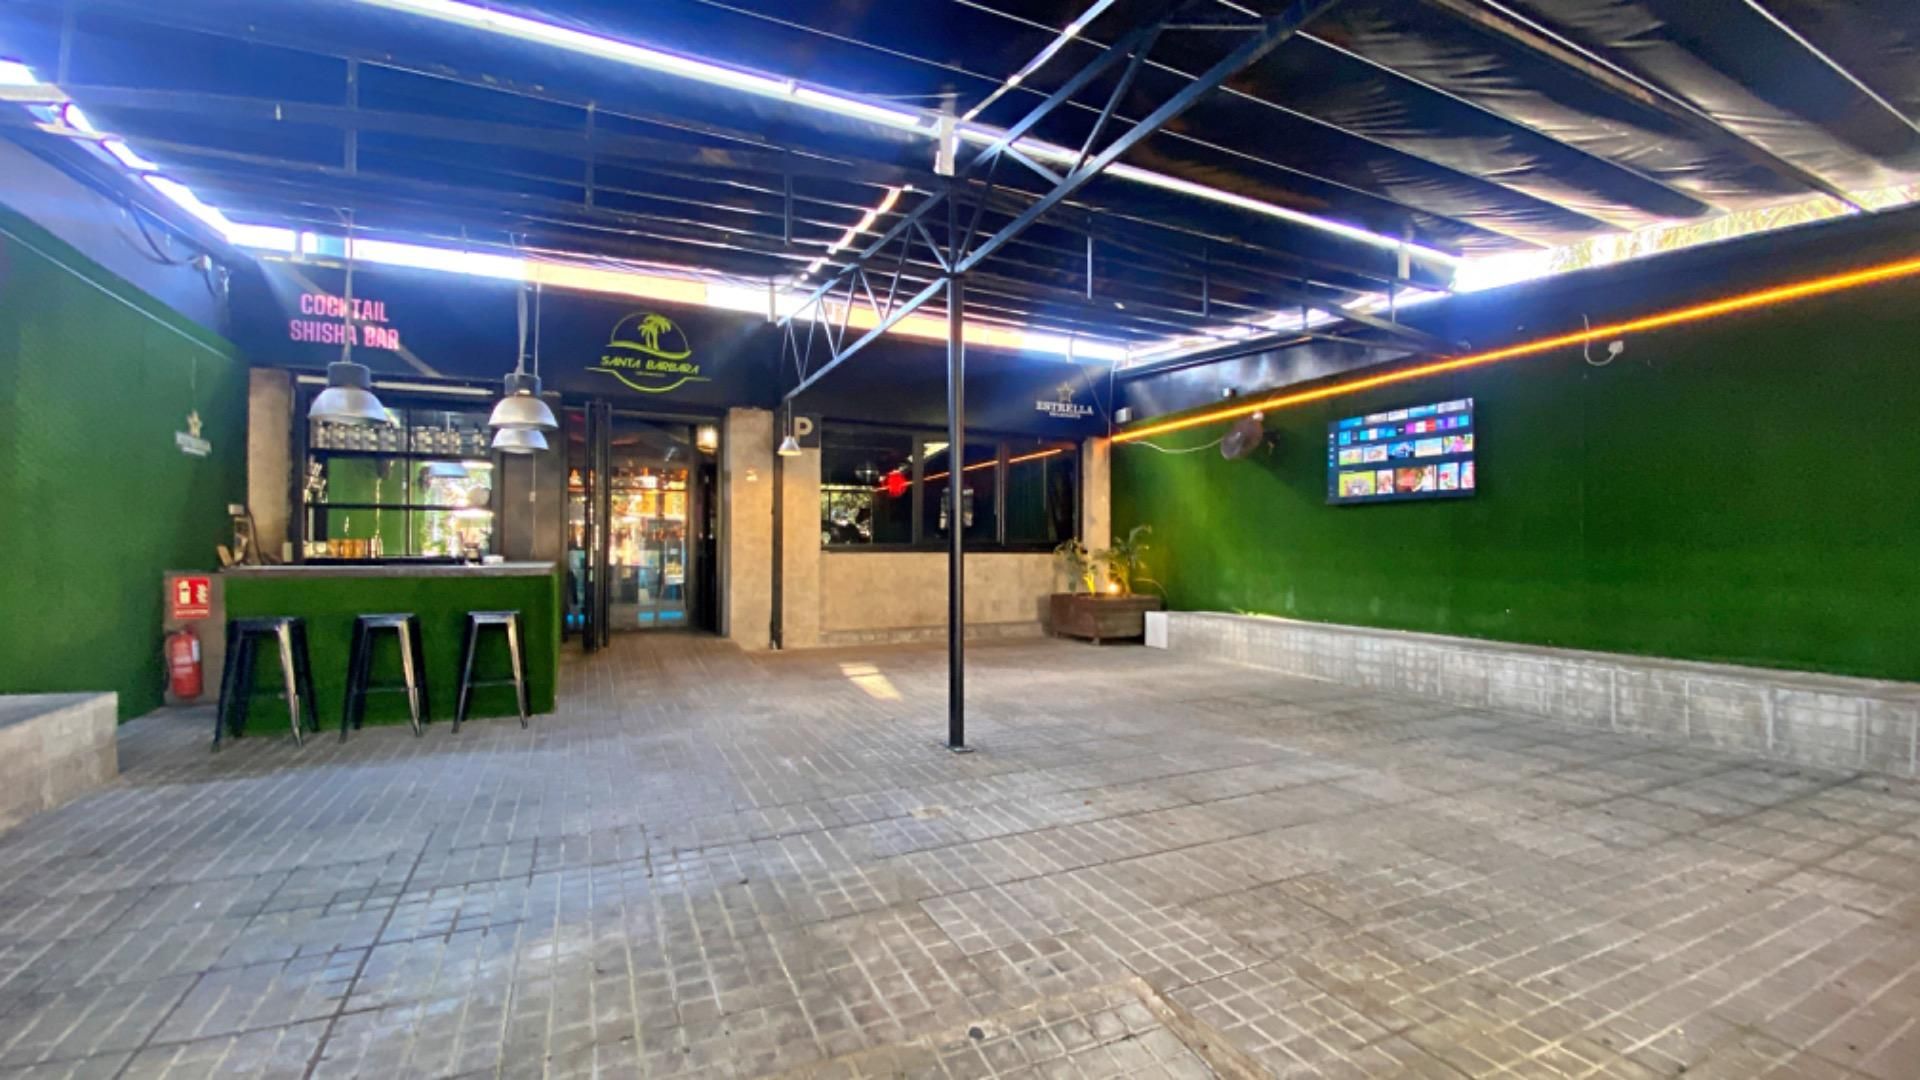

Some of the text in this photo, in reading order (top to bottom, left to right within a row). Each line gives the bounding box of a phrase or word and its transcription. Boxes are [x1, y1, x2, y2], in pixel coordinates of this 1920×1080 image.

[363, 324, 401, 351] BAR
[600, 355, 642, 369] SANTA
[645, 359, 700, 375] BARBARA
[1035, 400, 1095, 416] ESTRELLA
